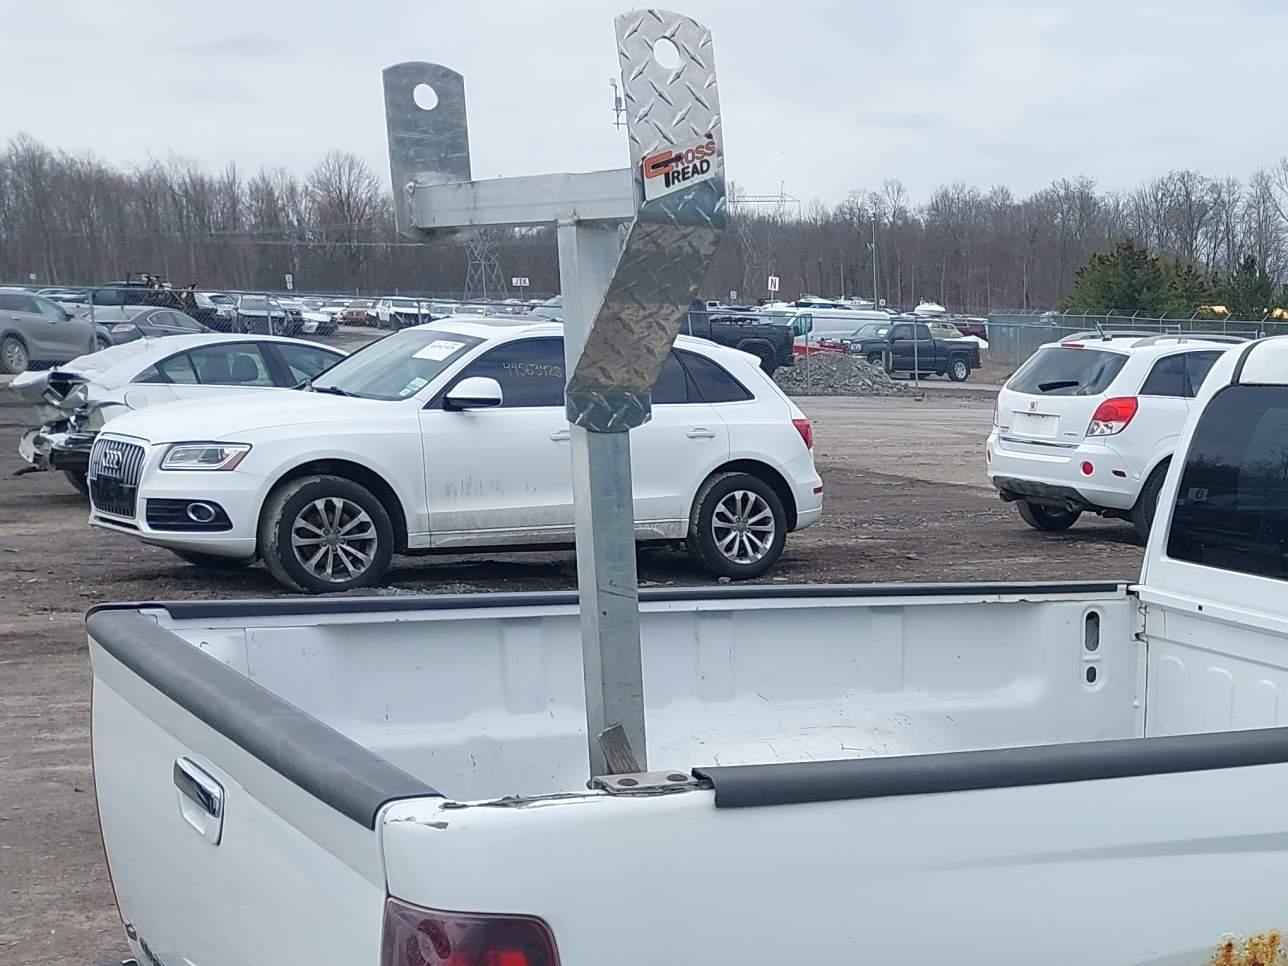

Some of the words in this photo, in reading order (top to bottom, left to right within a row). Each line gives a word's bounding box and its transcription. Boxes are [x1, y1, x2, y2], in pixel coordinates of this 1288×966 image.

[644, 141, 716, 179] CROSS
[655, 158, 711, 188] TREAD
[770, 278, 777, 290] N
